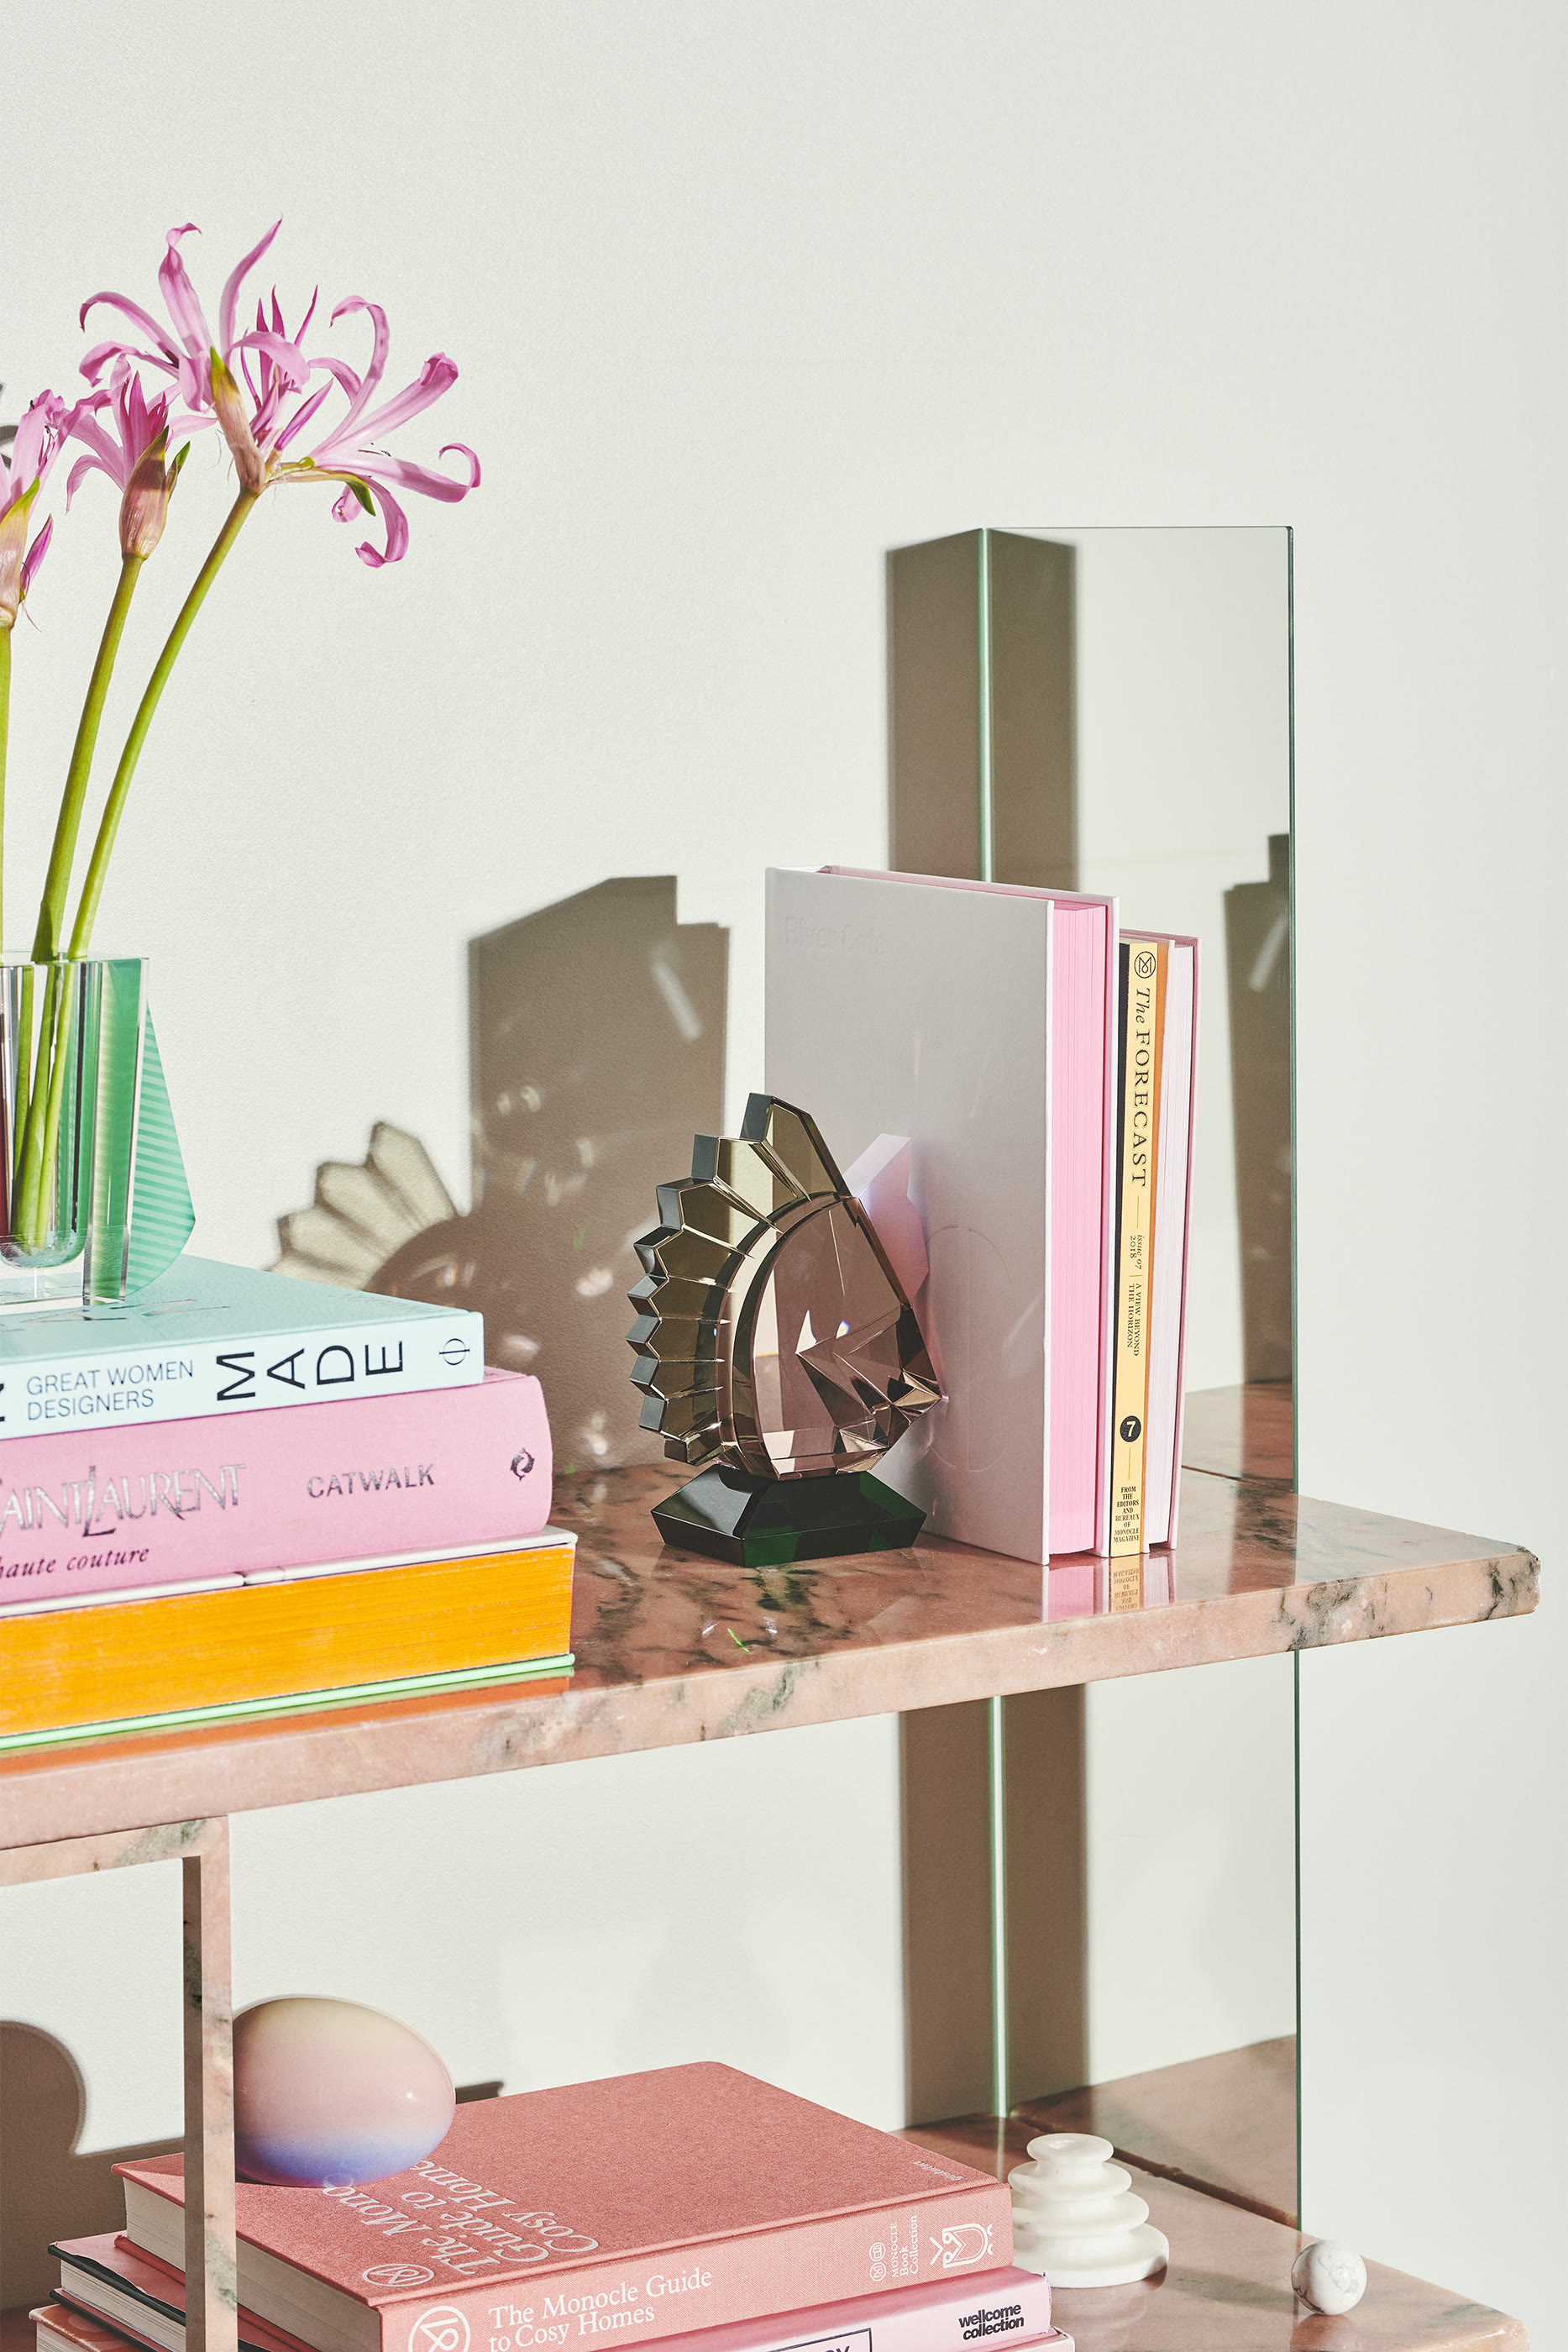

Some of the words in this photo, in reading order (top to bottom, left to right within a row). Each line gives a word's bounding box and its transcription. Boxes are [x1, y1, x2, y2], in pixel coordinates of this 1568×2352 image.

[1135, 988, 1151, 1024] The
[1130, 1029, 1151, 1188] FORECAST
[1136, 1234, 1145, 1257] issue
[1135, 1258, 1142, 1270] 07
[27, 1369, 101, 1395] GREAT
[108, 1360, 193, 1386] WOMEN
[216, 1340, 403, 1402] MADE
[28, 1389, 154, 1420] DESIGNERS
[1126, 1420, 1136, 1437] 7
[307, 1464, 435, 1499] CATWALK
[1116, 1499, 1140, 1508] EDITORS
[1114, 1528, 1140, 1536] MONOCLE
[1114, 1535, 1141, 1543] MAGAZINE
[66, 1548, 149, 1572] couture
[401, 2192, 448, 2210] to
[409, 2160, 517, 2212] Home
[323, 2187, 433, 2237] Mono
[439, 2211, 550, 2262] Guide
[501, 2211, 599, 2252] Cosy
[909, 2214, 919, 2275] Collection
[422, 2234, 501, 2276] The
[890, 2221, 899, 2278] MONOCLE
[899, 2245, 909, 2276] Book
[488, 2304, 534, 2329] The
[543, 2281, 638, 2320] Monocle
[646, 2267, 713, 2297] Guide
[489, 2335, 511, 2352] to
[514, 2323, 571, 2347] Cosy
[578, 2305, 655, 2336] Homes
[958, 2304, 1022, 2328] wellcome
[962, 2317, 1025, 2341] collection
